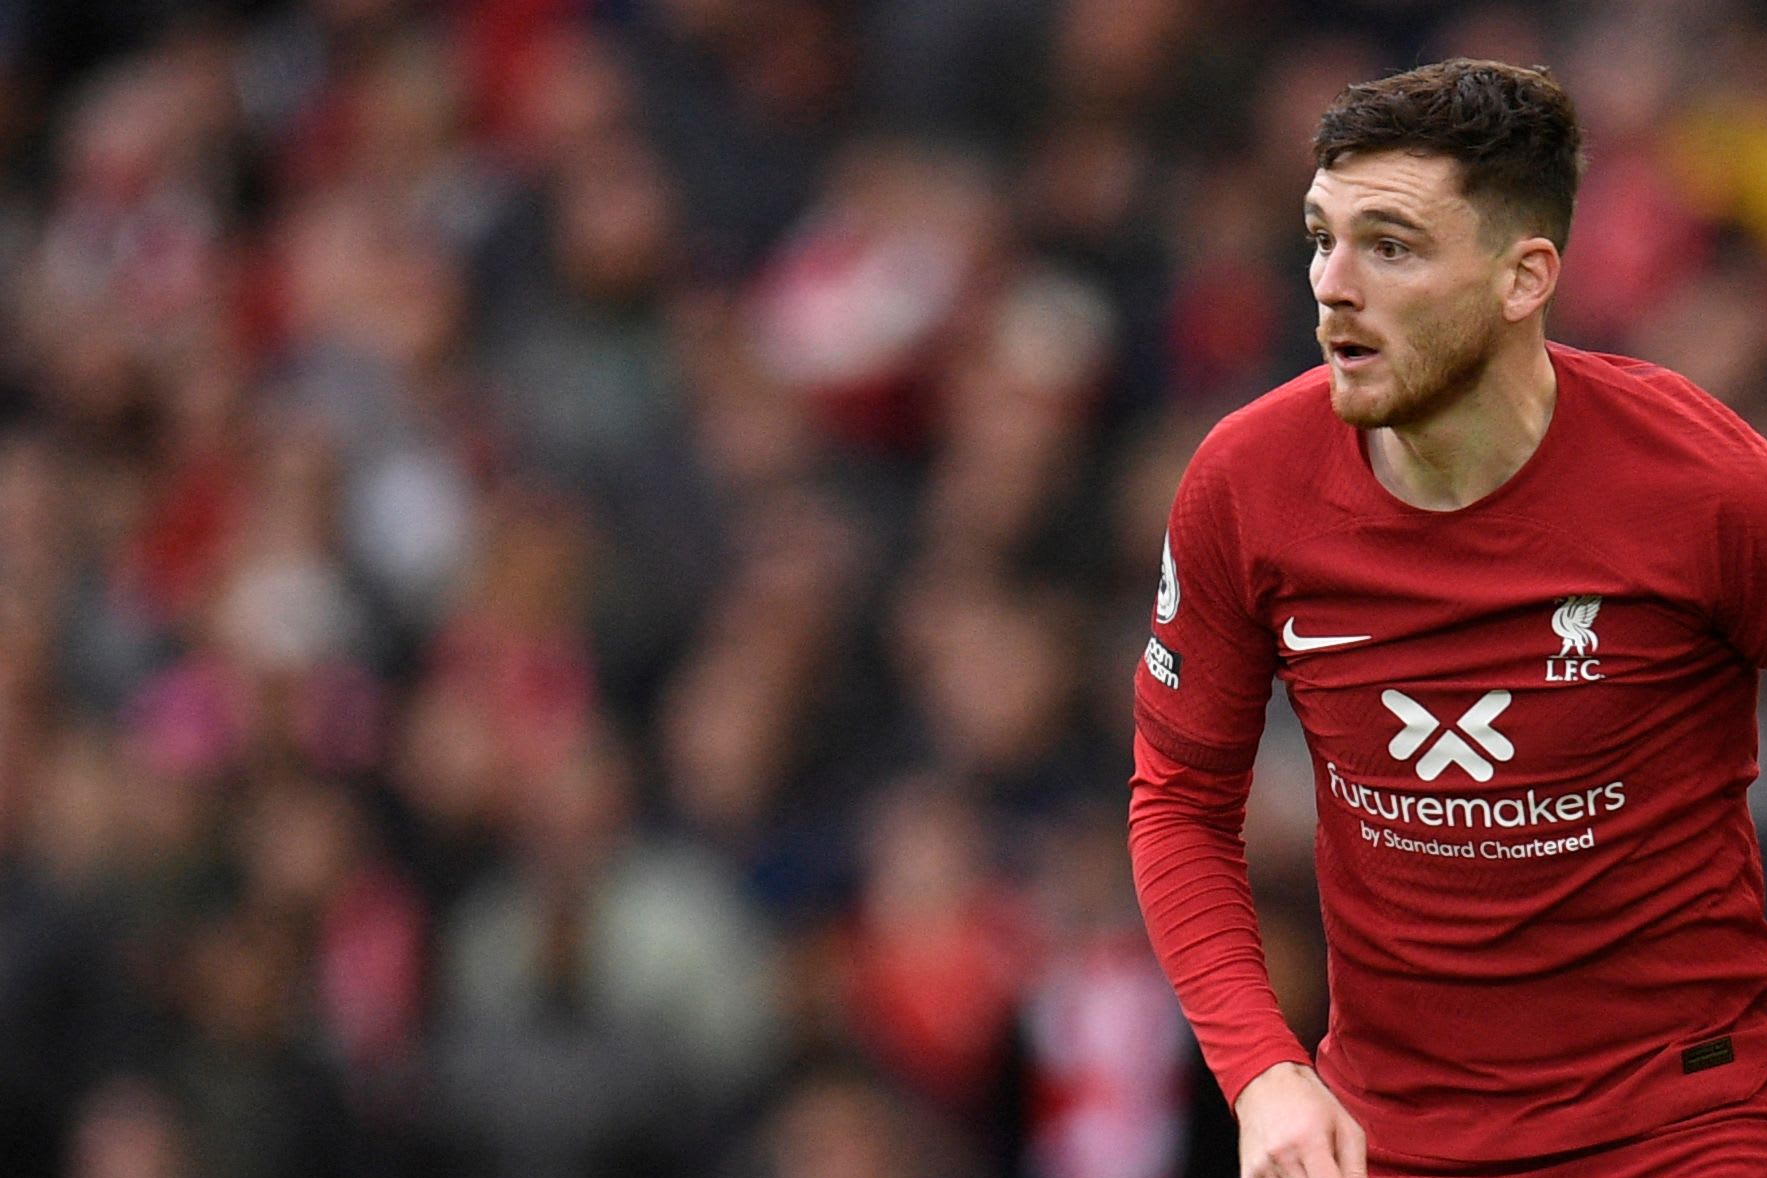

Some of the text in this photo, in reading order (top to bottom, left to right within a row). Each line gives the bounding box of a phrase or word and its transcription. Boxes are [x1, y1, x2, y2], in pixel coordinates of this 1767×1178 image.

[1361, 820, 1595, 860] by Standard Chartered
